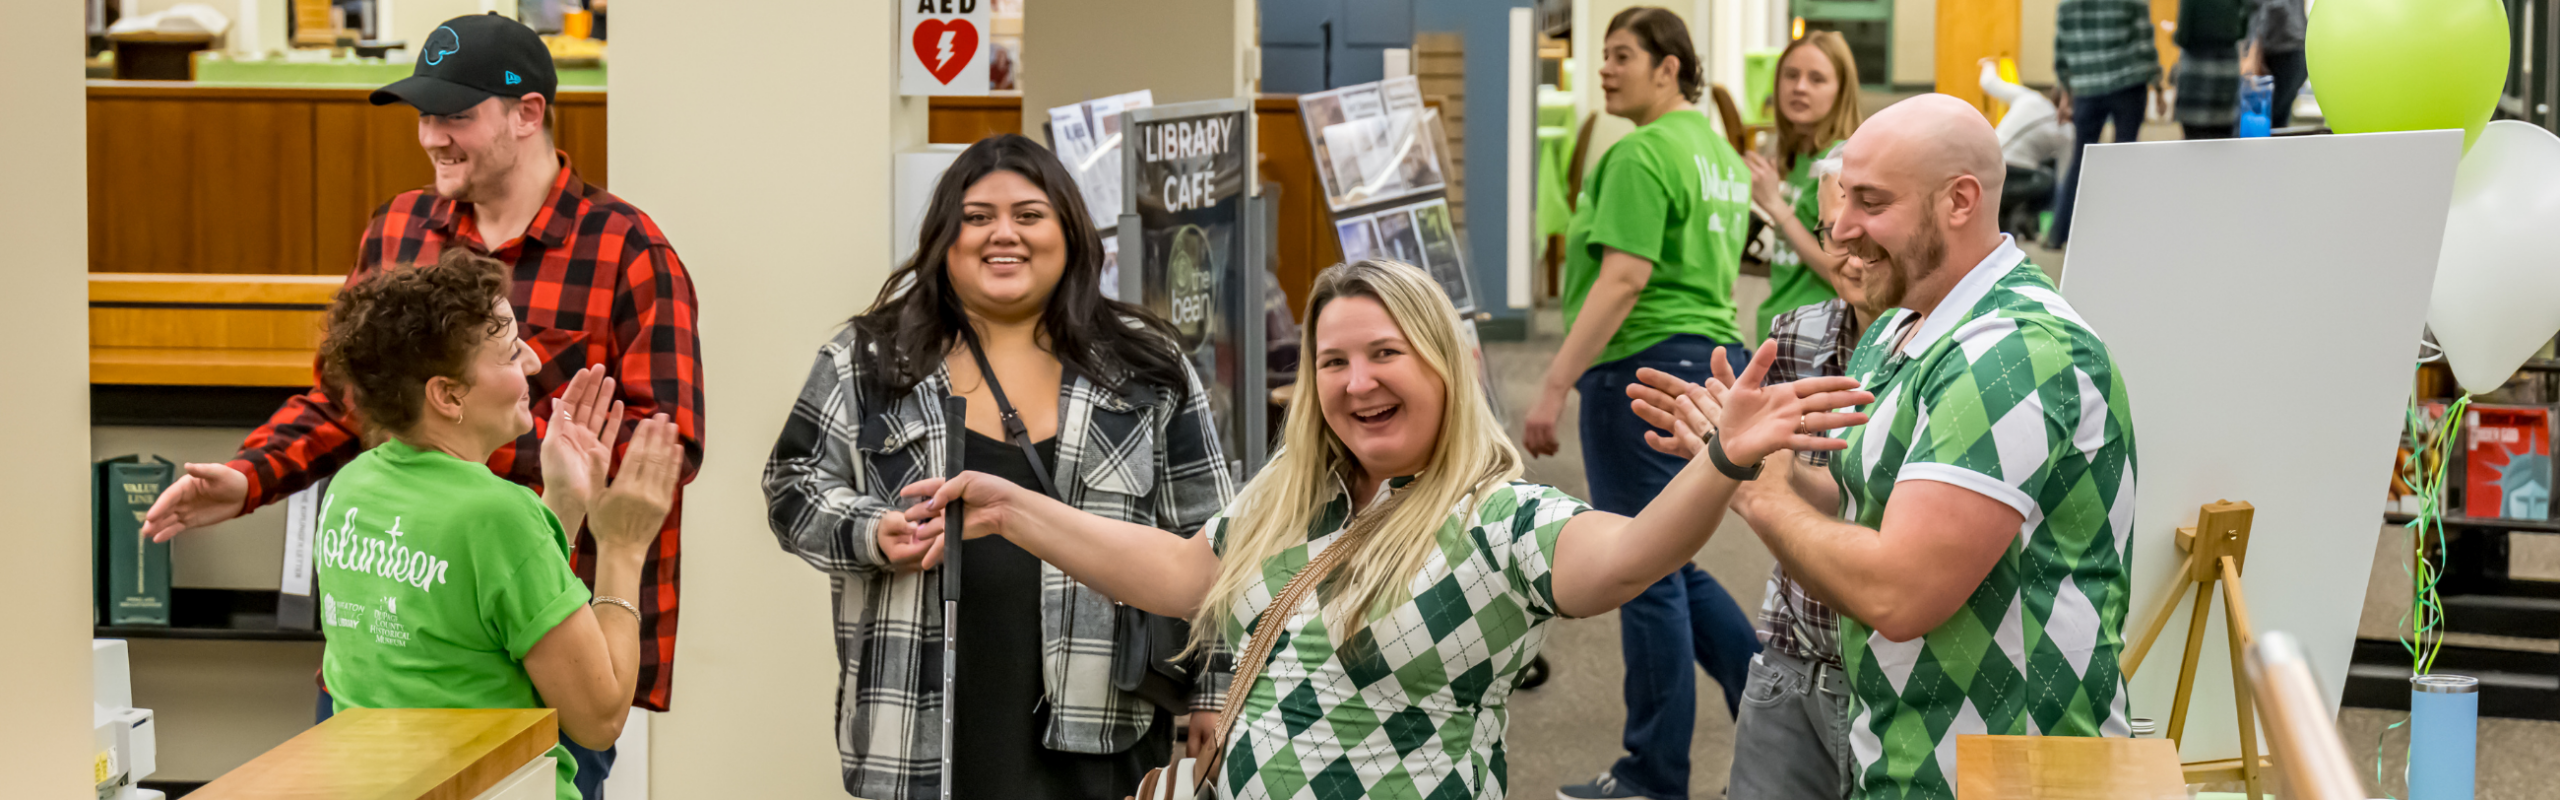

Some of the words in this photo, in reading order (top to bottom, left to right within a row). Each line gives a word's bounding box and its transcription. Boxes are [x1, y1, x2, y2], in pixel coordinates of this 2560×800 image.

[917, 0, 976, 14] AED
[1145, 117, 1232, 163] LIBRARY
[1163, 161, 1216, 214] CAFÉ
[1191, 266, 1211, 291] the
[1171, 289, 1211, 325] bean
[314, 493, 449, 592] Volunteer
